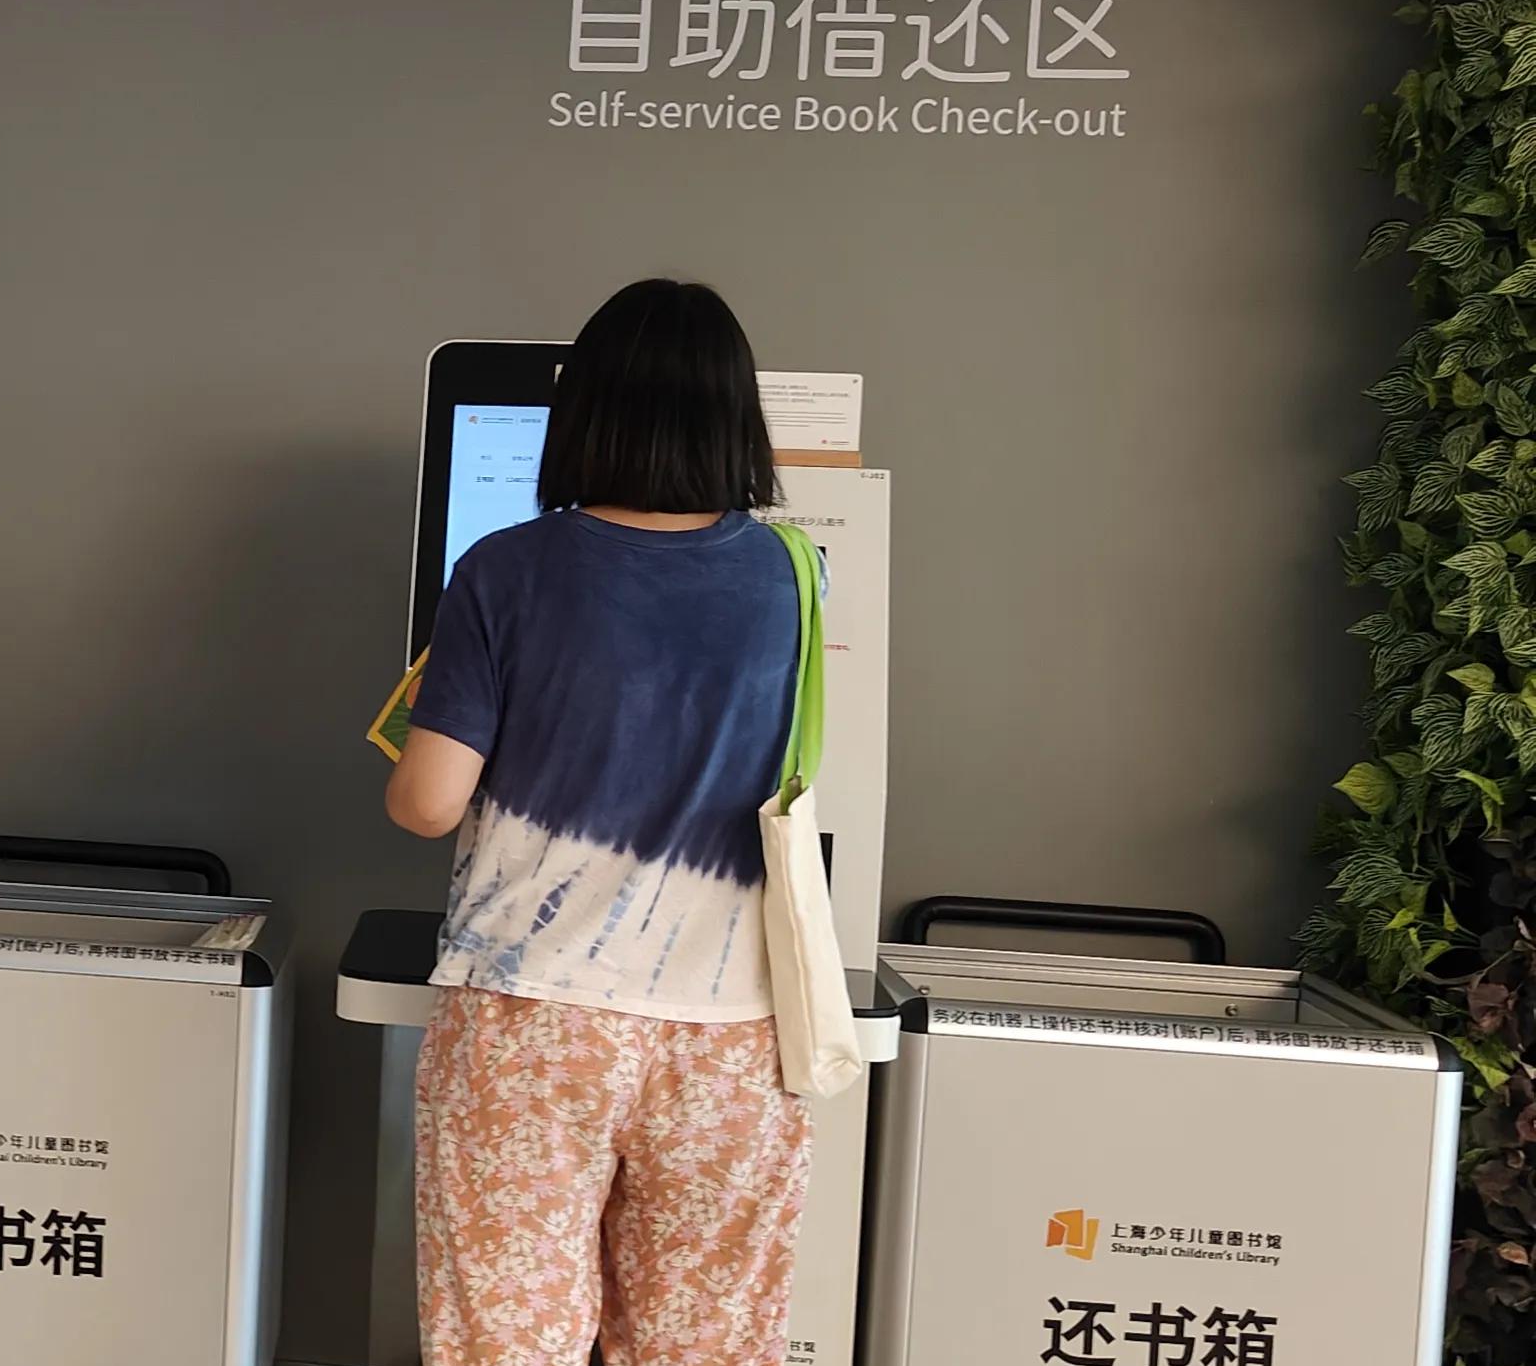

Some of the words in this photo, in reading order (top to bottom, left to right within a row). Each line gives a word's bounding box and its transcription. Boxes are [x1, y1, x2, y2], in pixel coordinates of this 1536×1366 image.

[548, 90, 782, 131] Self-service
[795, 96, 899, 133] Book
[911, 97, 1127, 137] Check-out
[11, 1153, 66, 1167] Children's
[69, 1156, 108, 1170] Library
[1111, 1223, 1283, 1250] 上海少年儿童图书馆
[1111, 1242, 1168, 1257] Shanghai
[1171, 1246, 1233, 1262] Children's
[1236, 1251, 1280, 1266] Library
[786, 1355, 813, 1365] ibrary
